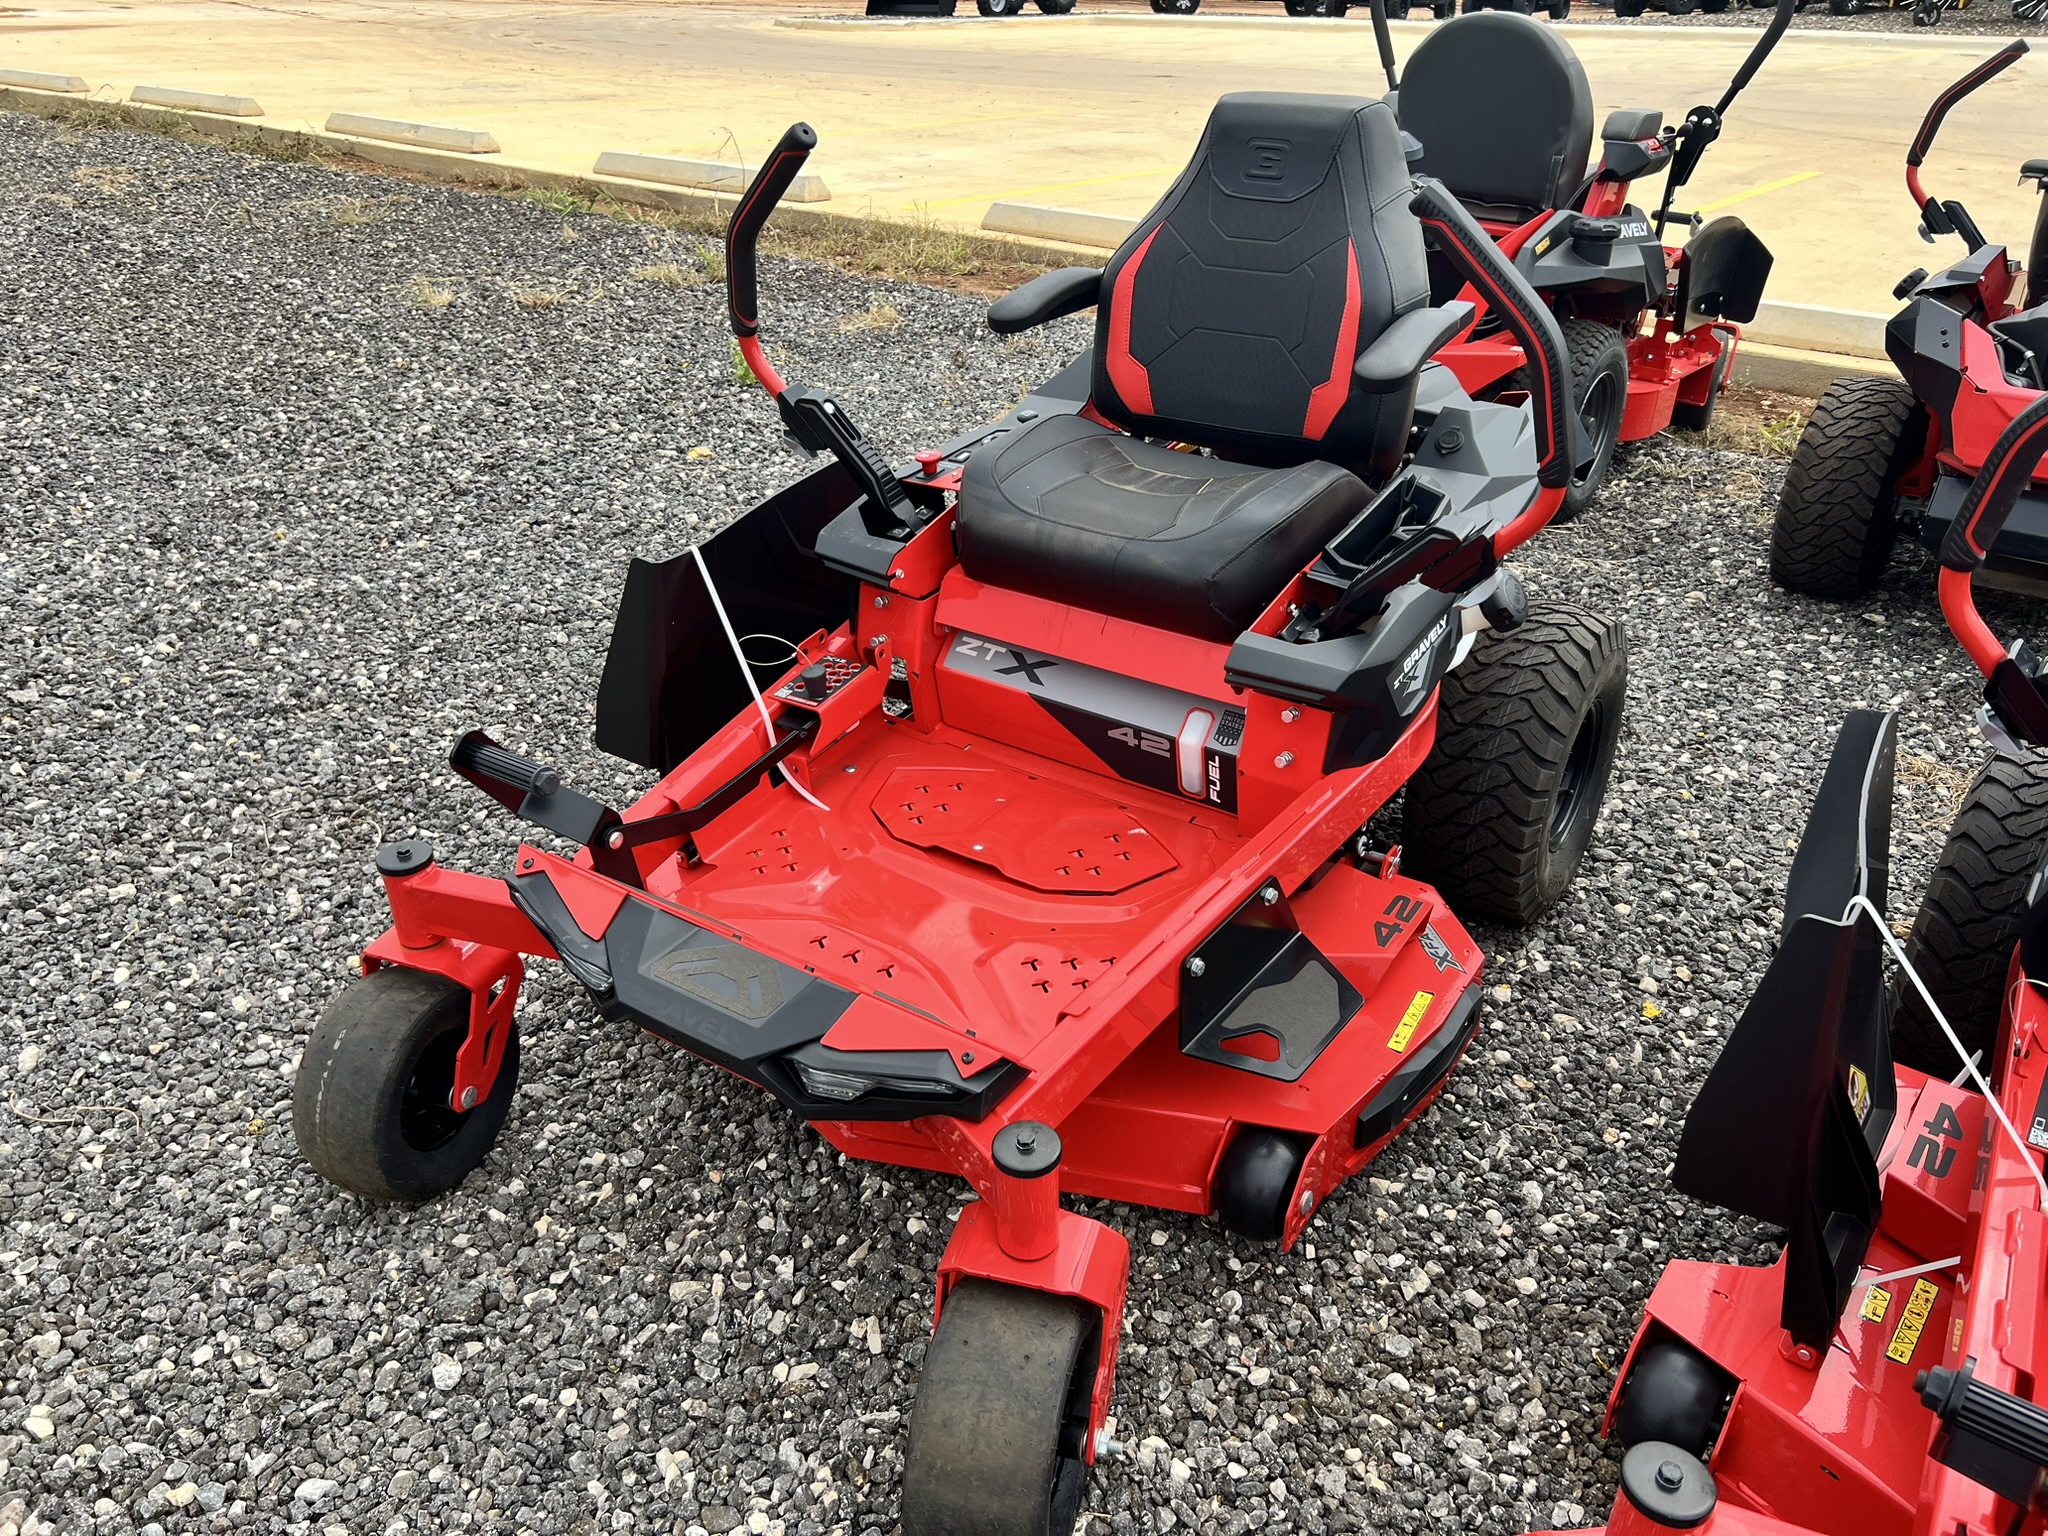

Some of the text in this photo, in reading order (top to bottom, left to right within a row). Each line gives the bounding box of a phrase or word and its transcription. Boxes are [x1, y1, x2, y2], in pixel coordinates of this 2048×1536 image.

[1619, 222, 1648, 239] AVELY
[955, 636, 1059, 686] ZTX
[1403, 614, 1447, 673] GRAVELY
[1221, 719, 1243, 730] STATES
[1223, 714, 1245, 725] UNITED
[1107, 726, 1171, 758] 42
[1209, 755, 1221, 803] FUEL
[1373, 895, 1422, 948] 42
[1420, 933, 1459, 968] X-FA
[1907, 1102, 1964, 1179] 42
